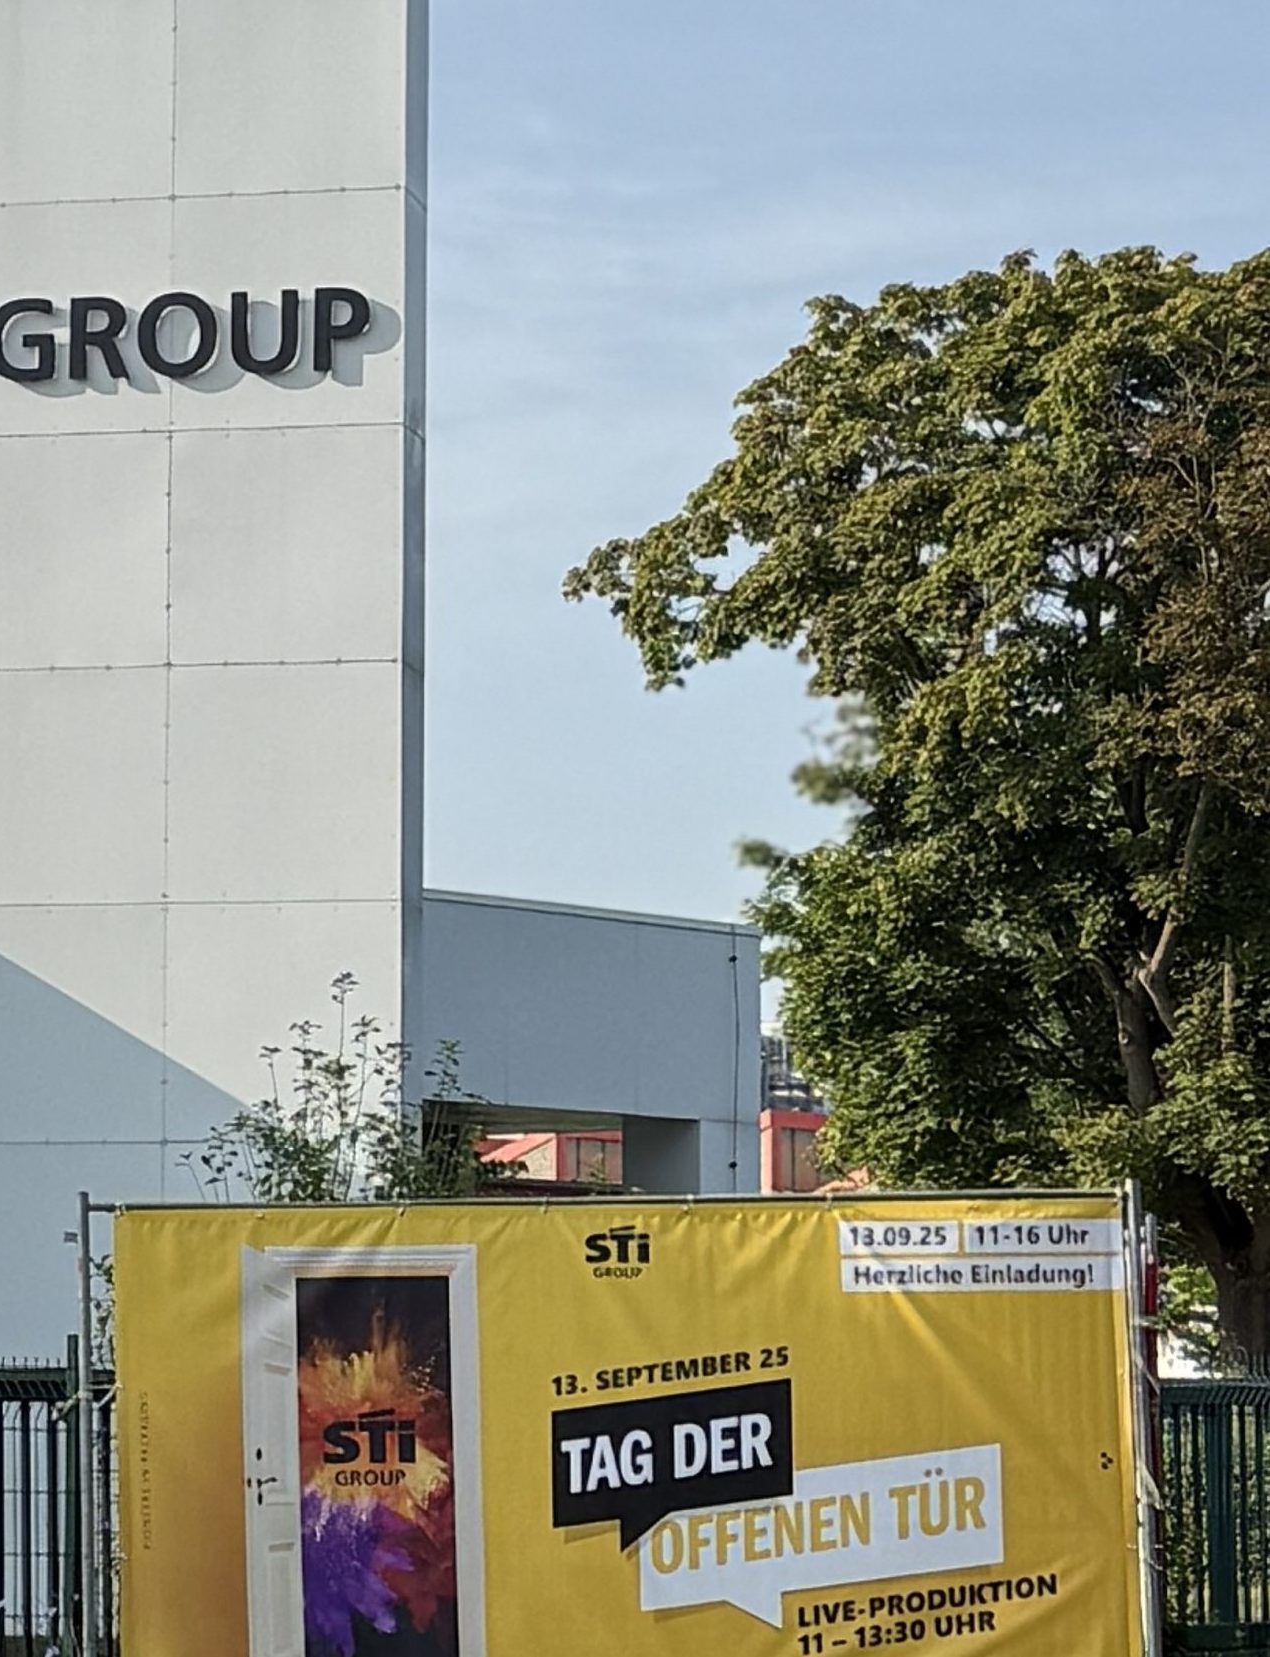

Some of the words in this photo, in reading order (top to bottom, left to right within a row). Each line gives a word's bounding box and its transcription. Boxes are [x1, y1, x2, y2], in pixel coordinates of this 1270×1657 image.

[849, 1226, 948, 1247] 13.09.25
[975, 1224, 1040, 1246] 11-16
[1048, 1223, 1090, 1245] Uhr
[592, 1266, 644, 1279] GROUP
[853, 1264, 963, 1285] Herzliche
[971, 1263, 1095, 1288] Einladung!
[551, 1374, 588, 1397] 13.
[595, 1351, 752, 1391] SEPTEMBER
[759, 1346, 790, 1369] 25
[560, 1429, 654, 1494] TAG
[673, 1412, 773, 1480] DER
[334, 1469, 407, 1487] GROUP
[650, 1491, 871, 1576] OFFENEN
[888, 1467, 987, 1541] TÜR
[797, 1573, 1058, 1628] LIVE-PRODUKTION
[797, 1633, 825, 1655] 11
[854, 1622, 927, 1648] 13:30
[934, 1610, 996, 1637] UHR
